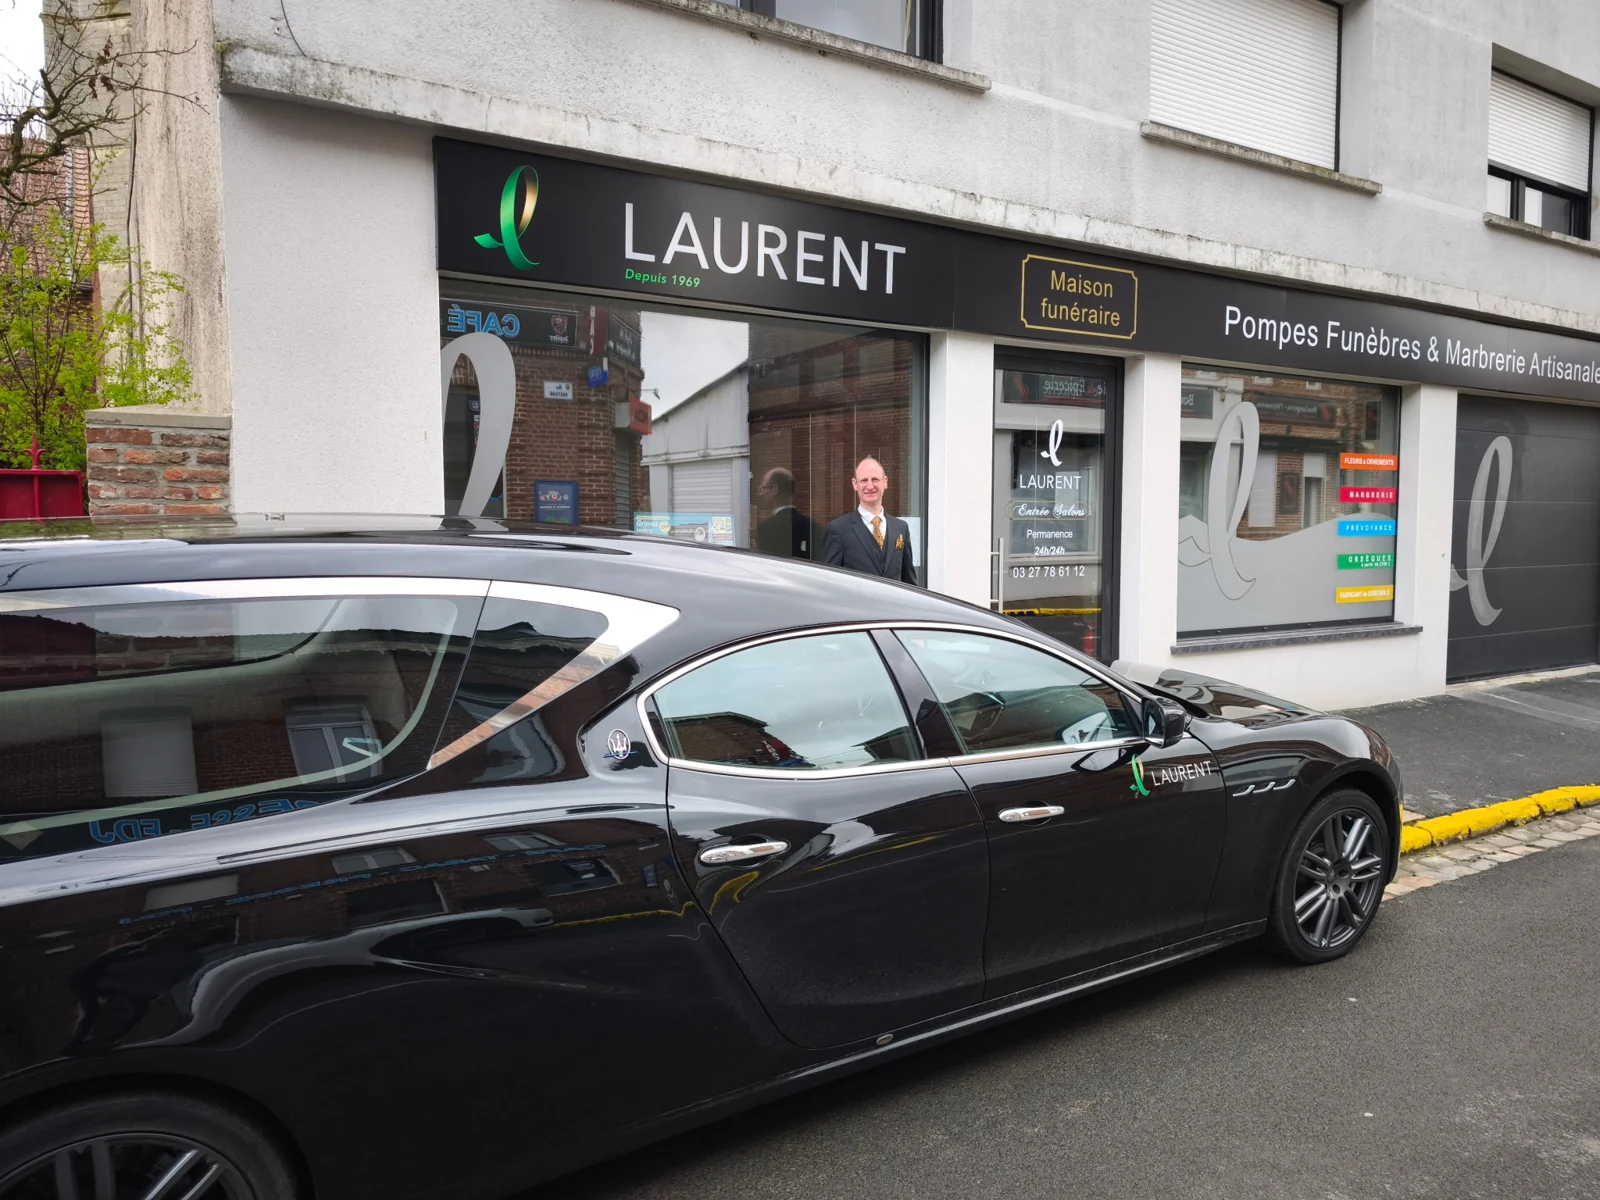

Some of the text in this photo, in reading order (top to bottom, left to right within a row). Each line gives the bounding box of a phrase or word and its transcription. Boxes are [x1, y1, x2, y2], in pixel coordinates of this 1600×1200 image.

[624, 202, 907, 295] LAURENT
[625, 268, 701, 289] Depuis 1969
[1050, 270, 1114, 298] Maison
[1041, 297, 1121, 327] funéraire
[1224, 305, 1600, 384] Pompes Funèbres & Marbrerie Artisanale
[1019, 474, 1082, 490] LAURENT
[1349, 491, 1394, 499] MARBRERIE
[1012, 503, 1088, 519] Entrée Salons
[1026, 529, 1073, 539] Permanence
[1345, 524, 1393, 532] PRÉVOYANCE
[1034, 546, 1066, 556] 24h/24h
[1012, 565, 1085, 579] 03 27 78 61 12
[1151, 760, 1212, 786] LAURENT
